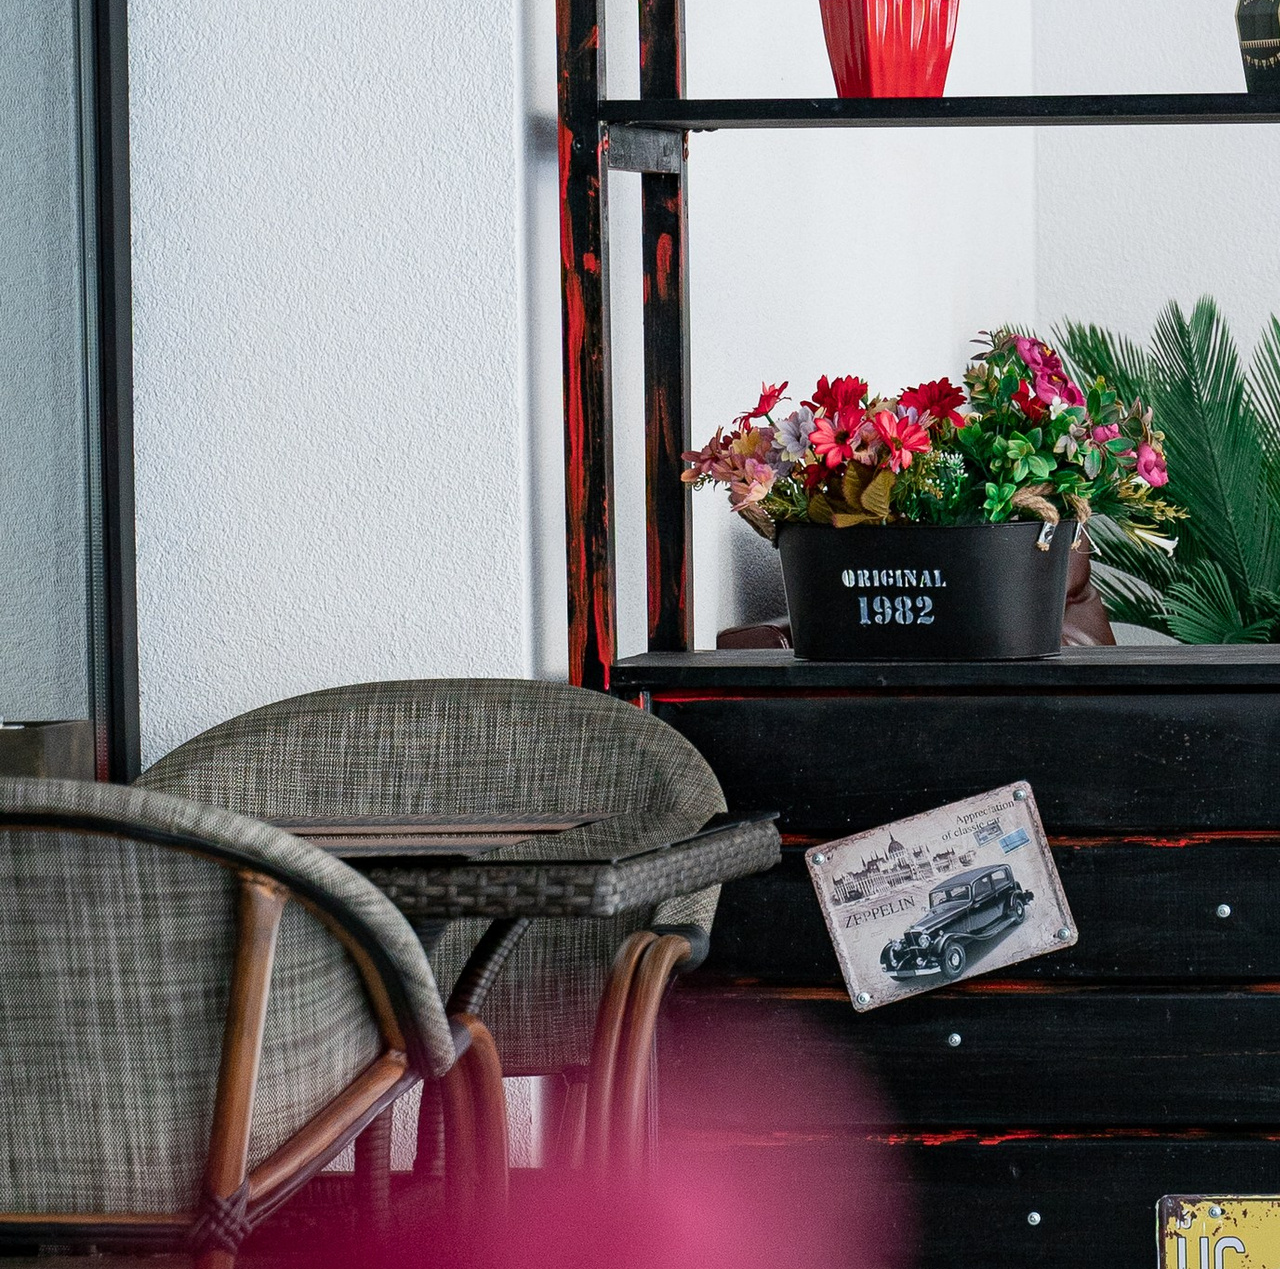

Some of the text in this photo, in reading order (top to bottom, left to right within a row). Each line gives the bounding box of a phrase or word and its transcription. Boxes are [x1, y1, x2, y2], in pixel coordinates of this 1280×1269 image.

[841, 569, 947, 587] ORIGINAL
[857, 595, 935, 625] 1982
[956, 800, 1015, 825] Appreciation
[941, 831, 951, 841] of
[953, 821, 985, 838] classic
[844, 895, 916, 928] ZEPPELIN
